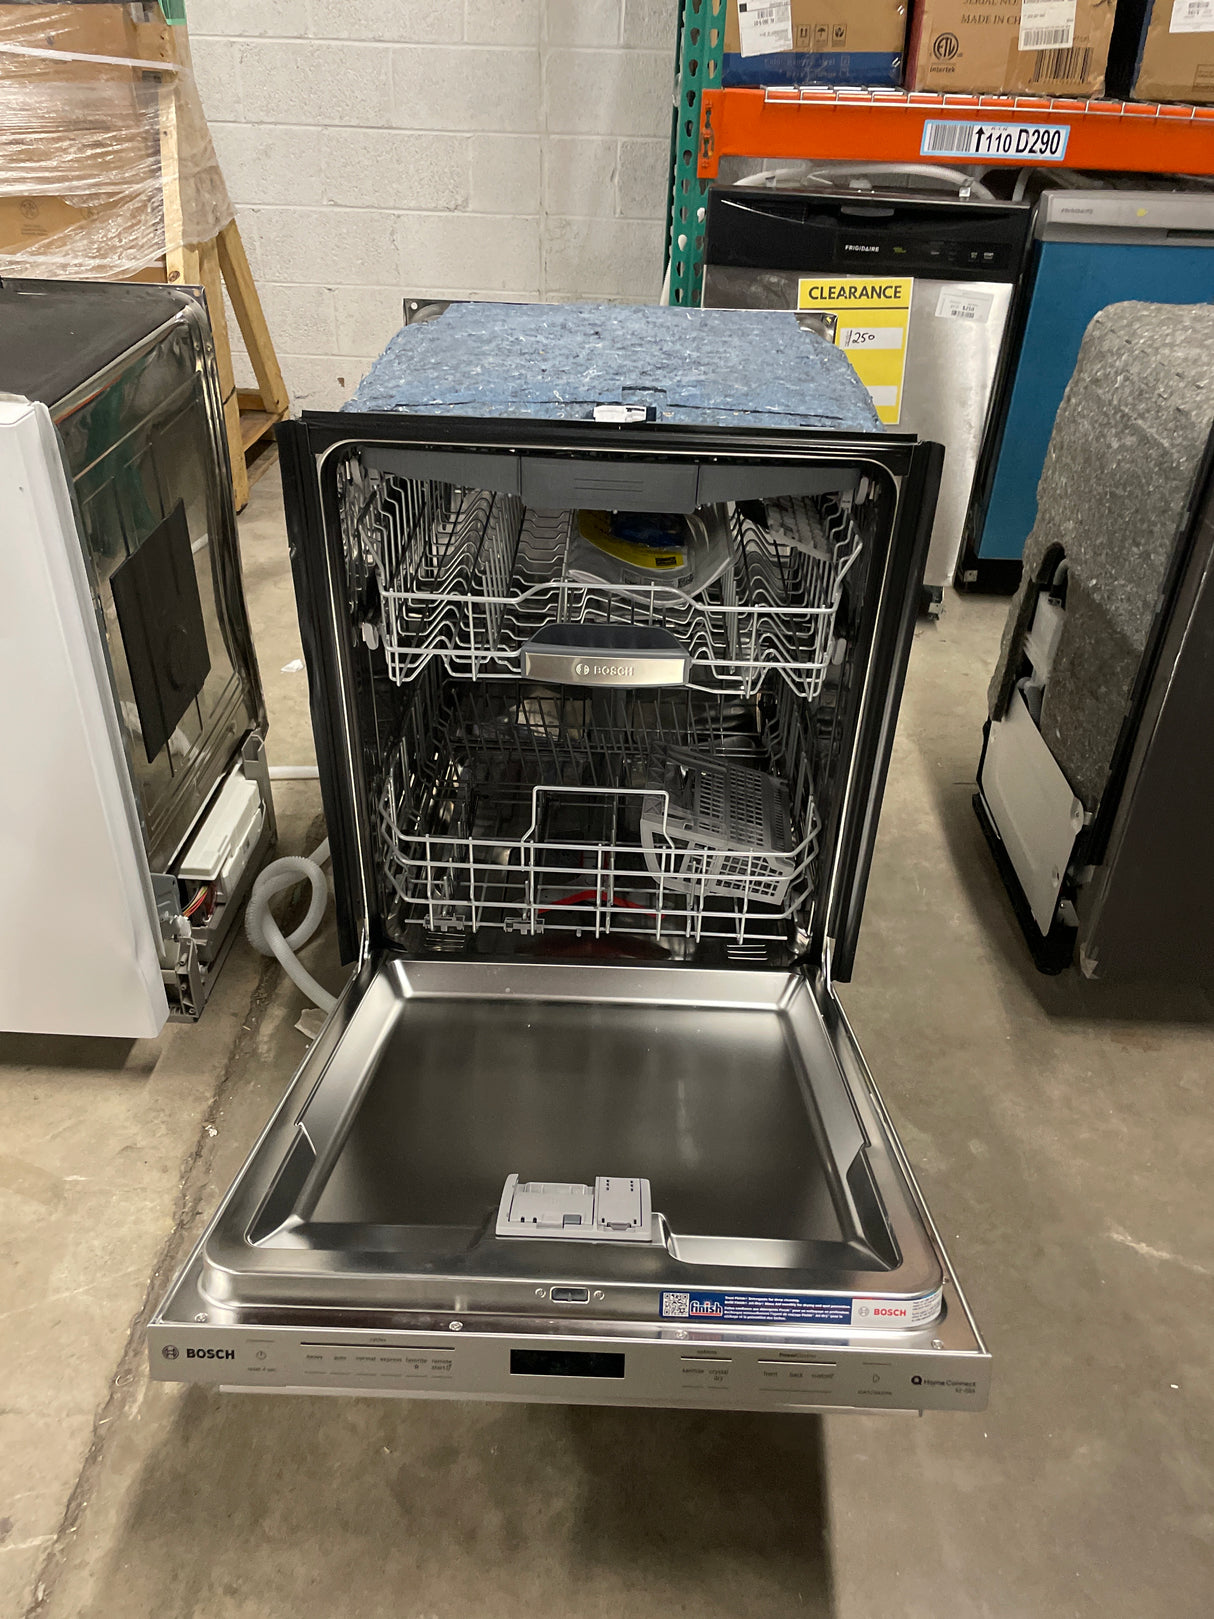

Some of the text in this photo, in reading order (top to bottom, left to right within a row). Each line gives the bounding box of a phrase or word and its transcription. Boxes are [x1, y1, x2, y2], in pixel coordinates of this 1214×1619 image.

[960, 14, 991, 25] MADE
[993, 14, 1004, 25] IN
[1006, 15, 1022, 26] CH
[985, 128, 1061, 155] 110 D290
[844, 244, 880, 253] FRIGIDAIRE
[808, 285, 903, 300] CLEARANCE
[593, 665, 634, 677] BOSCH
[690, 1300, 723, 1316] finish
[873, 1308, 907, 1318] BOSCH
[186, 1347, 236, 1361] BOSCH
[923, 1379, 977, 1388] Home Connect
